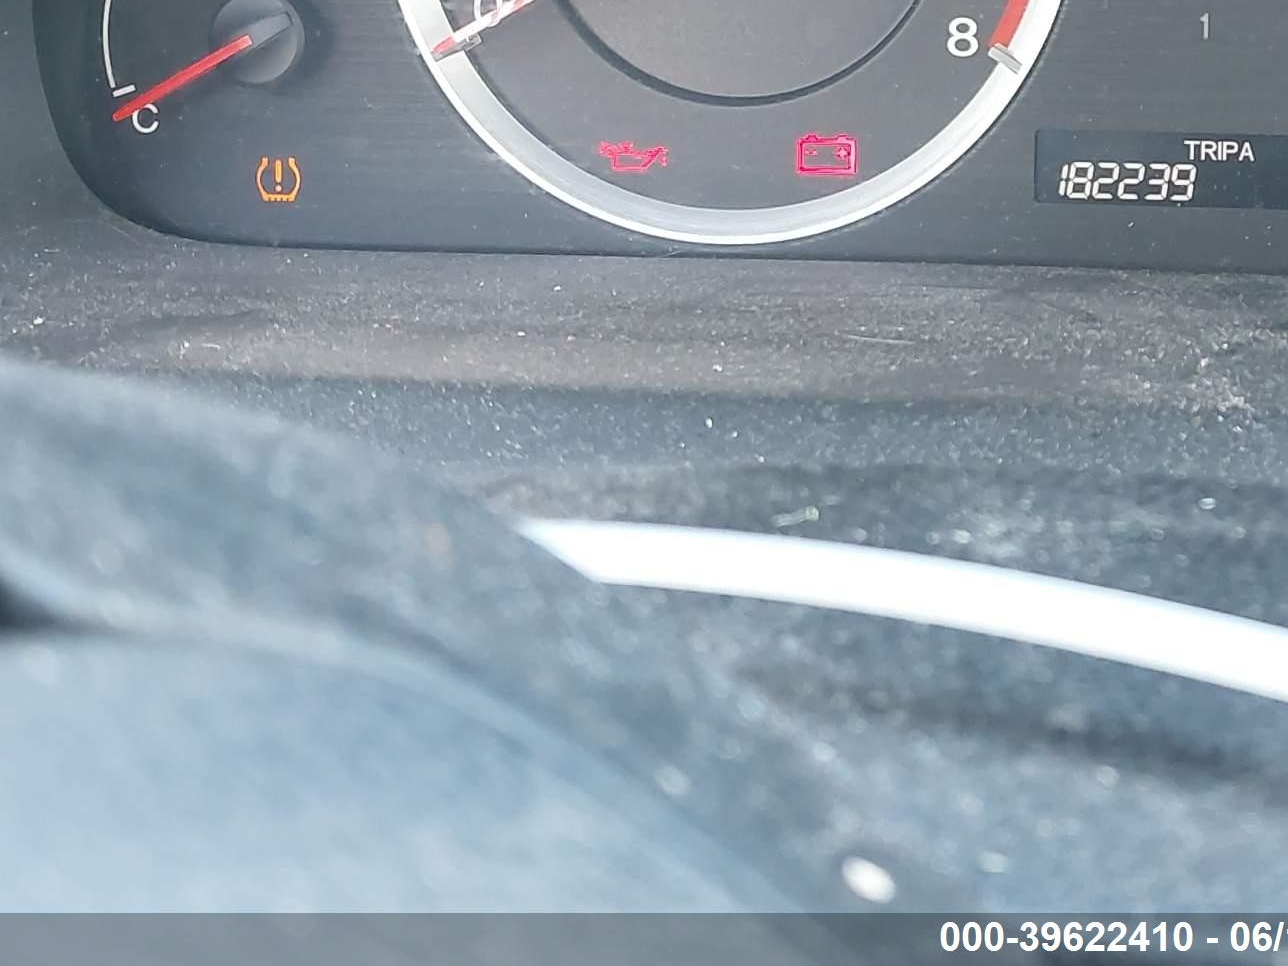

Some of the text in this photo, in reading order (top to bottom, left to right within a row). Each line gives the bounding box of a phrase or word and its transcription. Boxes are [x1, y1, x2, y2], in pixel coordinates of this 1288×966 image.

[947, 18, 978, 56] 8
[1200, 14, 1208, 38] 1
[131, 104, 159, 133] C
[1058, 162, 1196, 200] 182239
